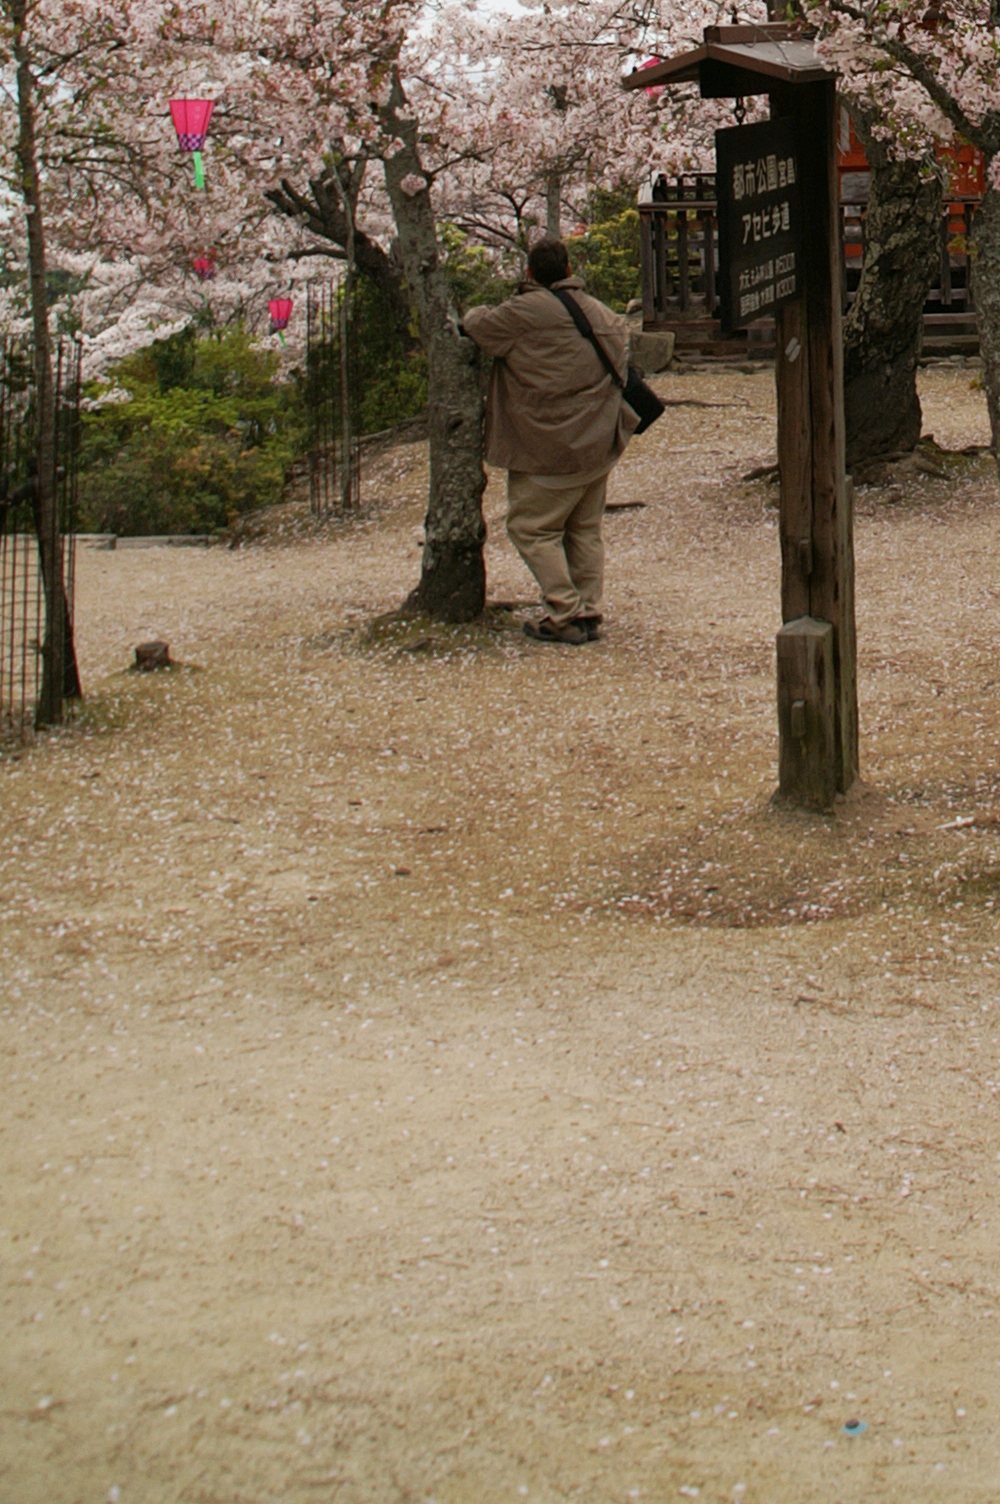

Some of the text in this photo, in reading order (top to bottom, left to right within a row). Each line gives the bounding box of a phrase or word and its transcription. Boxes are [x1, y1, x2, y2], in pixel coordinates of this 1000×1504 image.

[741, 201, 790, 246] アセビ歩道
